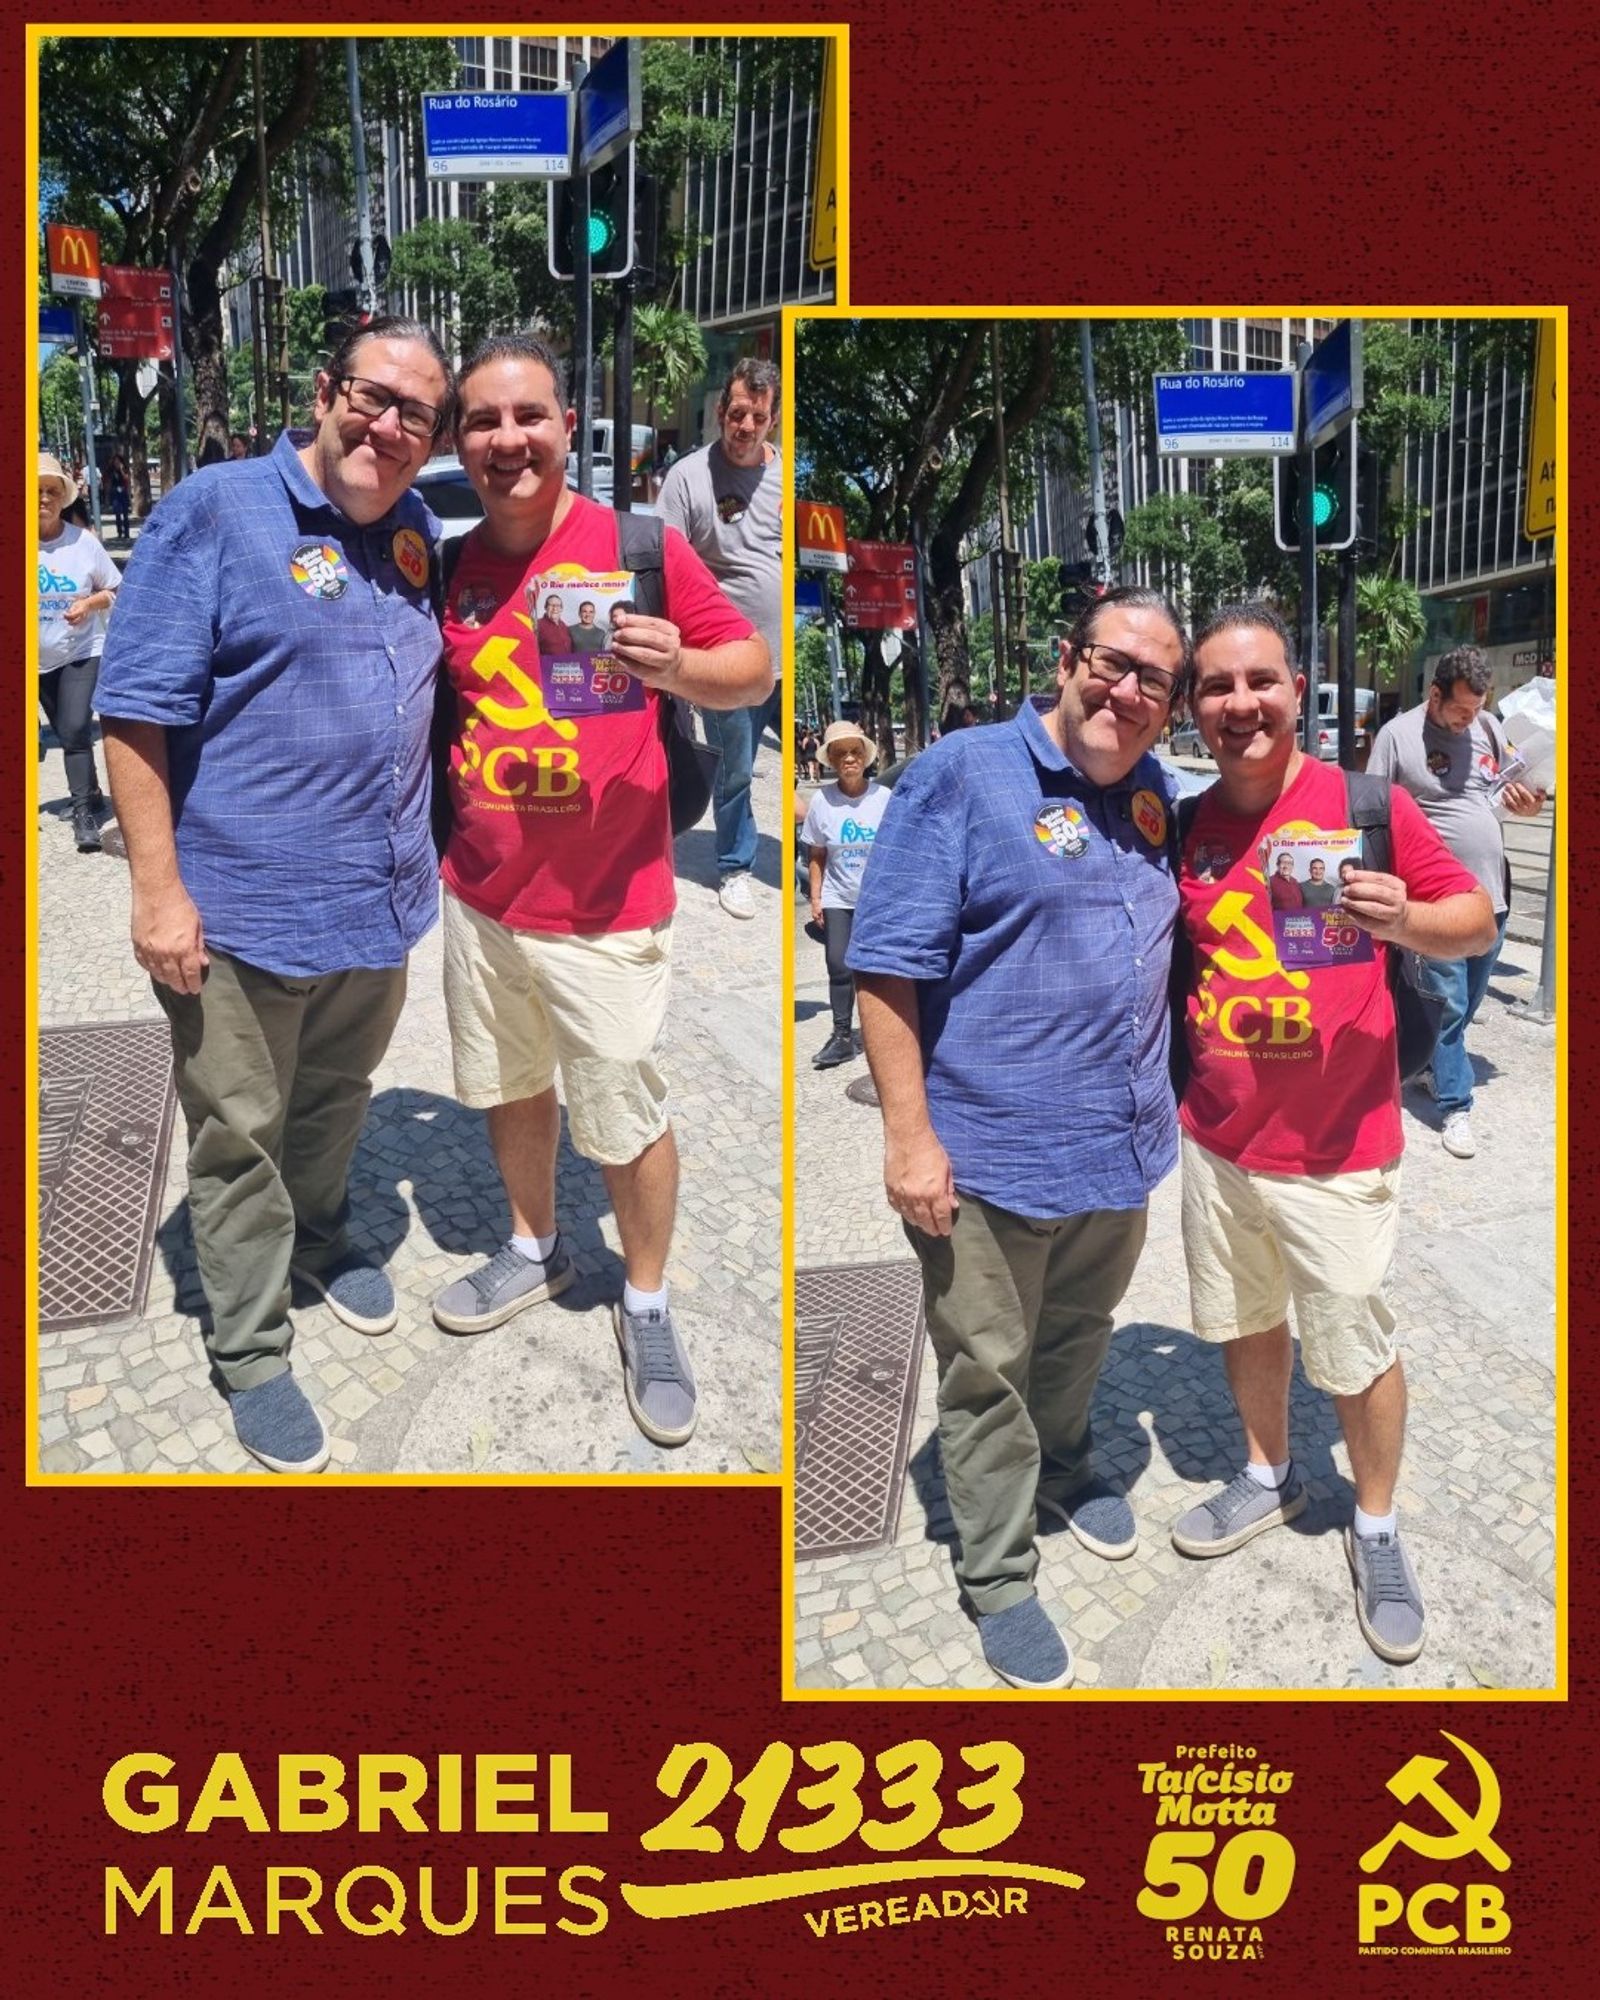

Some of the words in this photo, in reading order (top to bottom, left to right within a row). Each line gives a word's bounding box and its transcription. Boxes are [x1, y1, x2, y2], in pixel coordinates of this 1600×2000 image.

[429, 98, 451, 110] Rua
[455, 96, 471, 109] do
[474, 96, 518, 108] Rosário
[432, 160, 448, 173] 96
[545, 159, 564, 171] 114
[1160, 378, 1182, 390] Rua
[1185, 377, 1200, 389] do
[1203, 375, 1245, 388] Rosário
[1164, 438, 1179, 450] 96
[1271, 436, 1289, 448] 114
[308, 559, 336, 588] 50
[590, 672, 630, 695] 50
[1051, 820, 1079, 848] 50
[1321, 926, 1360, 948] 50
